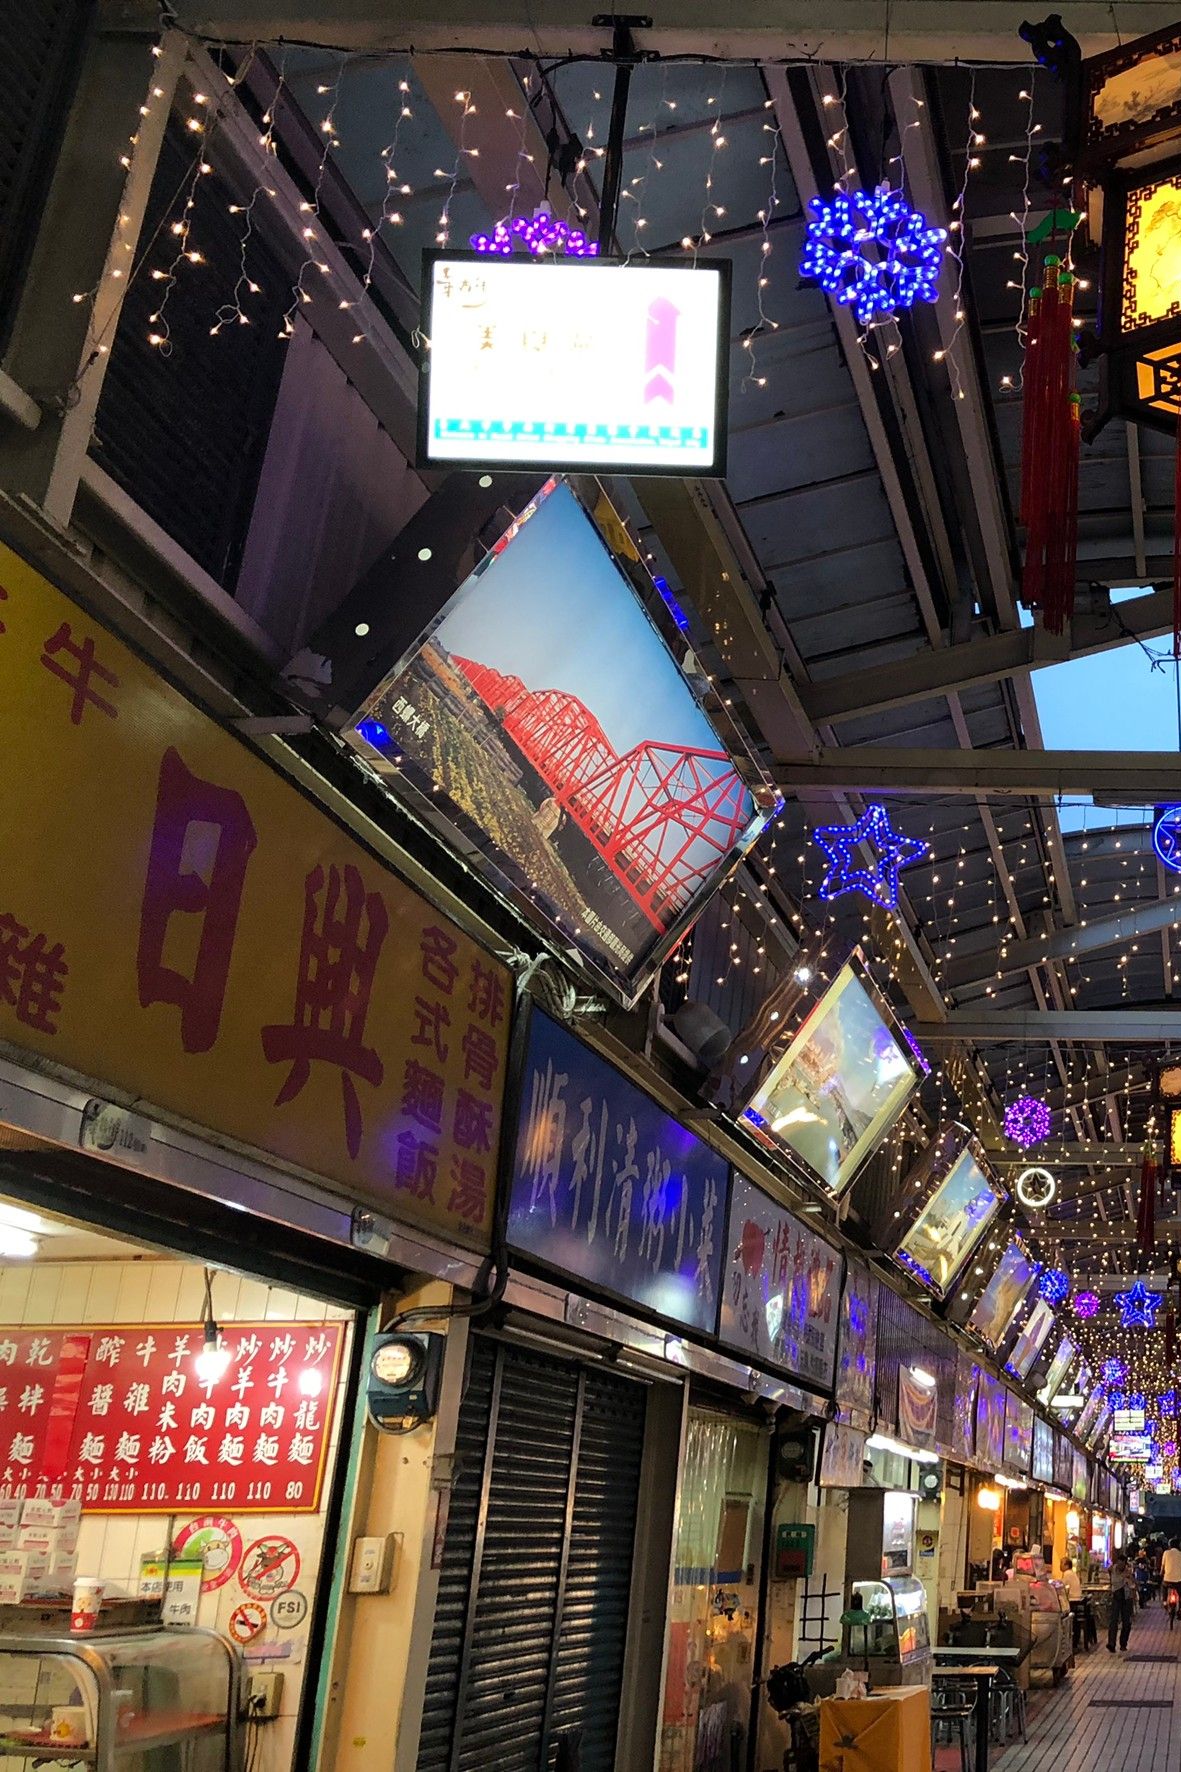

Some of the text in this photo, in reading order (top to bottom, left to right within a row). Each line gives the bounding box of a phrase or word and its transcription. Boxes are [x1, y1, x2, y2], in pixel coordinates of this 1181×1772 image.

[392, 696, 431, 739] 西螺大橋
[137, 745, 388, 1160] 日興
[520, 1056, 718, 1302] 順利清粥小菜
[148, 1334, 192, 1465] 羊肉米粉
[217, 1333, 263, 1466] 炒羊肉麵
[252, 1333, 297, 1466] 炒牛肉麵
[287, 1333, 332, 1466] 炒龍麵
[286, 1481, 303, 1499] 80
